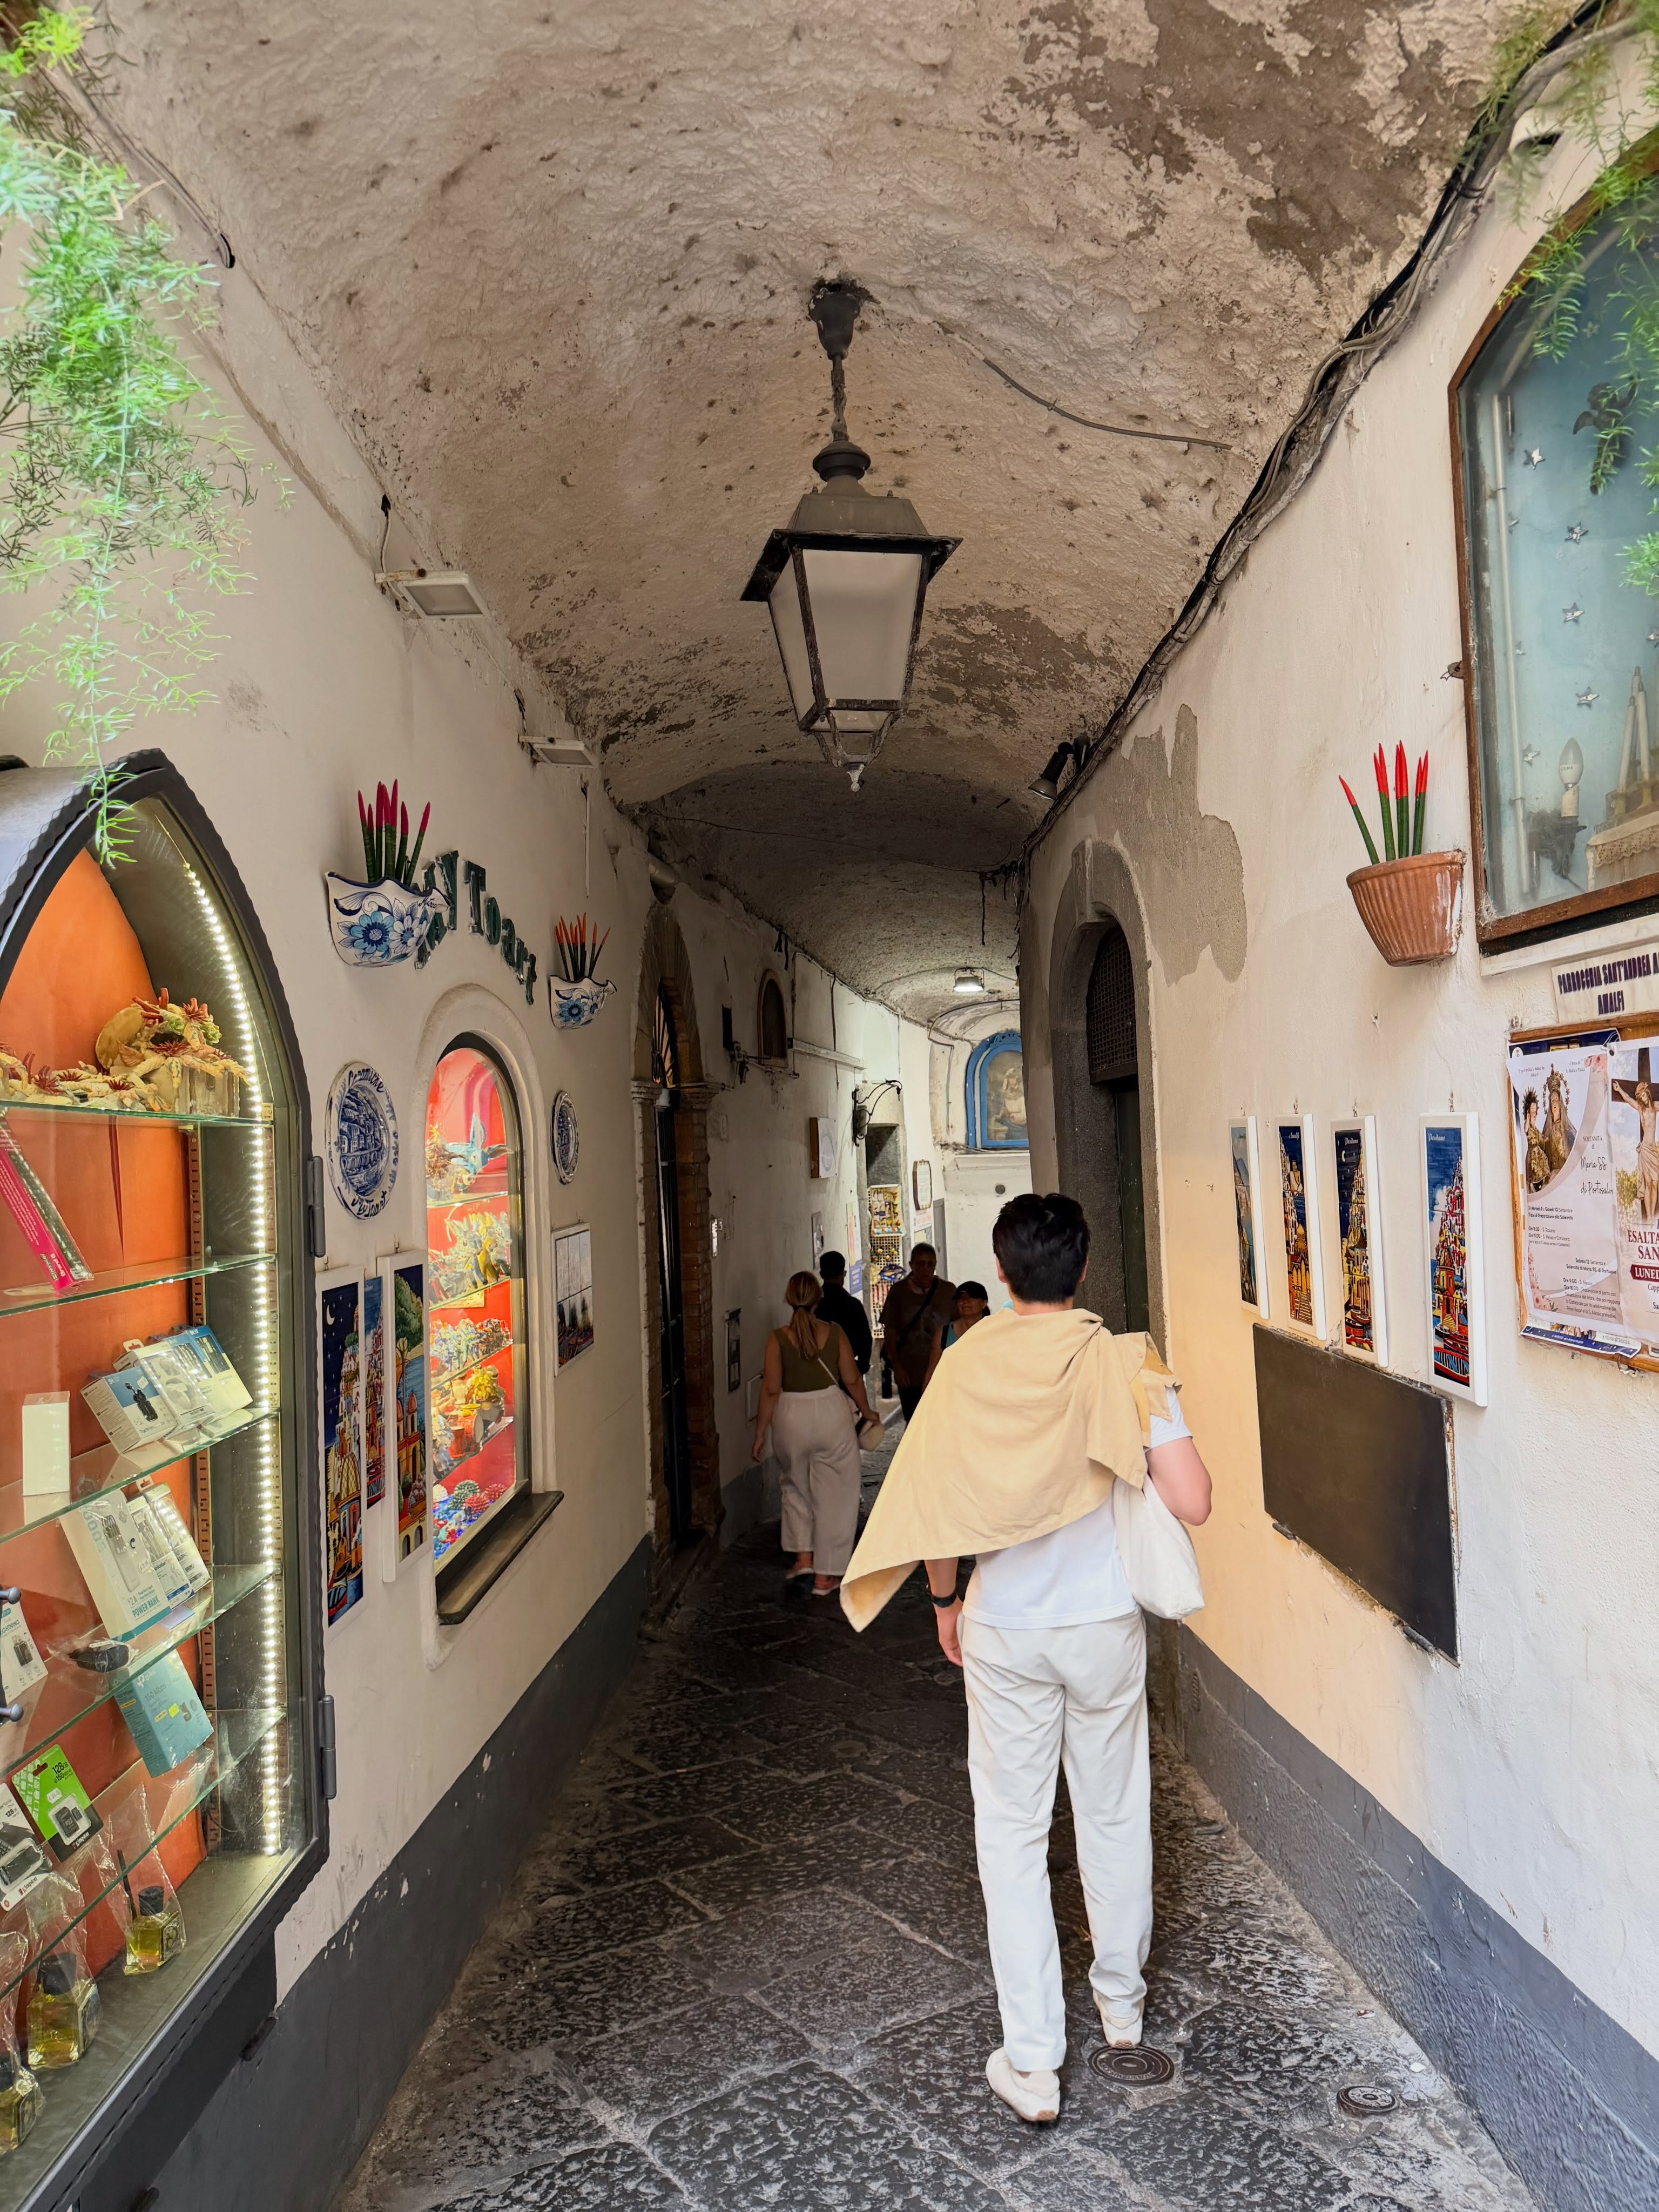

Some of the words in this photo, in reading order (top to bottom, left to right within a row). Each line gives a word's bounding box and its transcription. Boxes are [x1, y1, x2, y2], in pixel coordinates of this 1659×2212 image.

[1557, 966, 1602, 995] PARROCCHIA
[1602, 954, 1651, 986] SANT'ANDREA
[1653, 952, 1659, 975] A
[1597, 990, 1624, 1015] AMALFI
[1581, 1157, 1597, 1171] Maria
[1580, 1182, 1587, 1196] di
[132, 1604, 150, 1618] POWER
[147, 1595, 160, 1609] BANK
[52, 1762, 65, 1775] 128
[5, 1809, 15, 1818] 128
